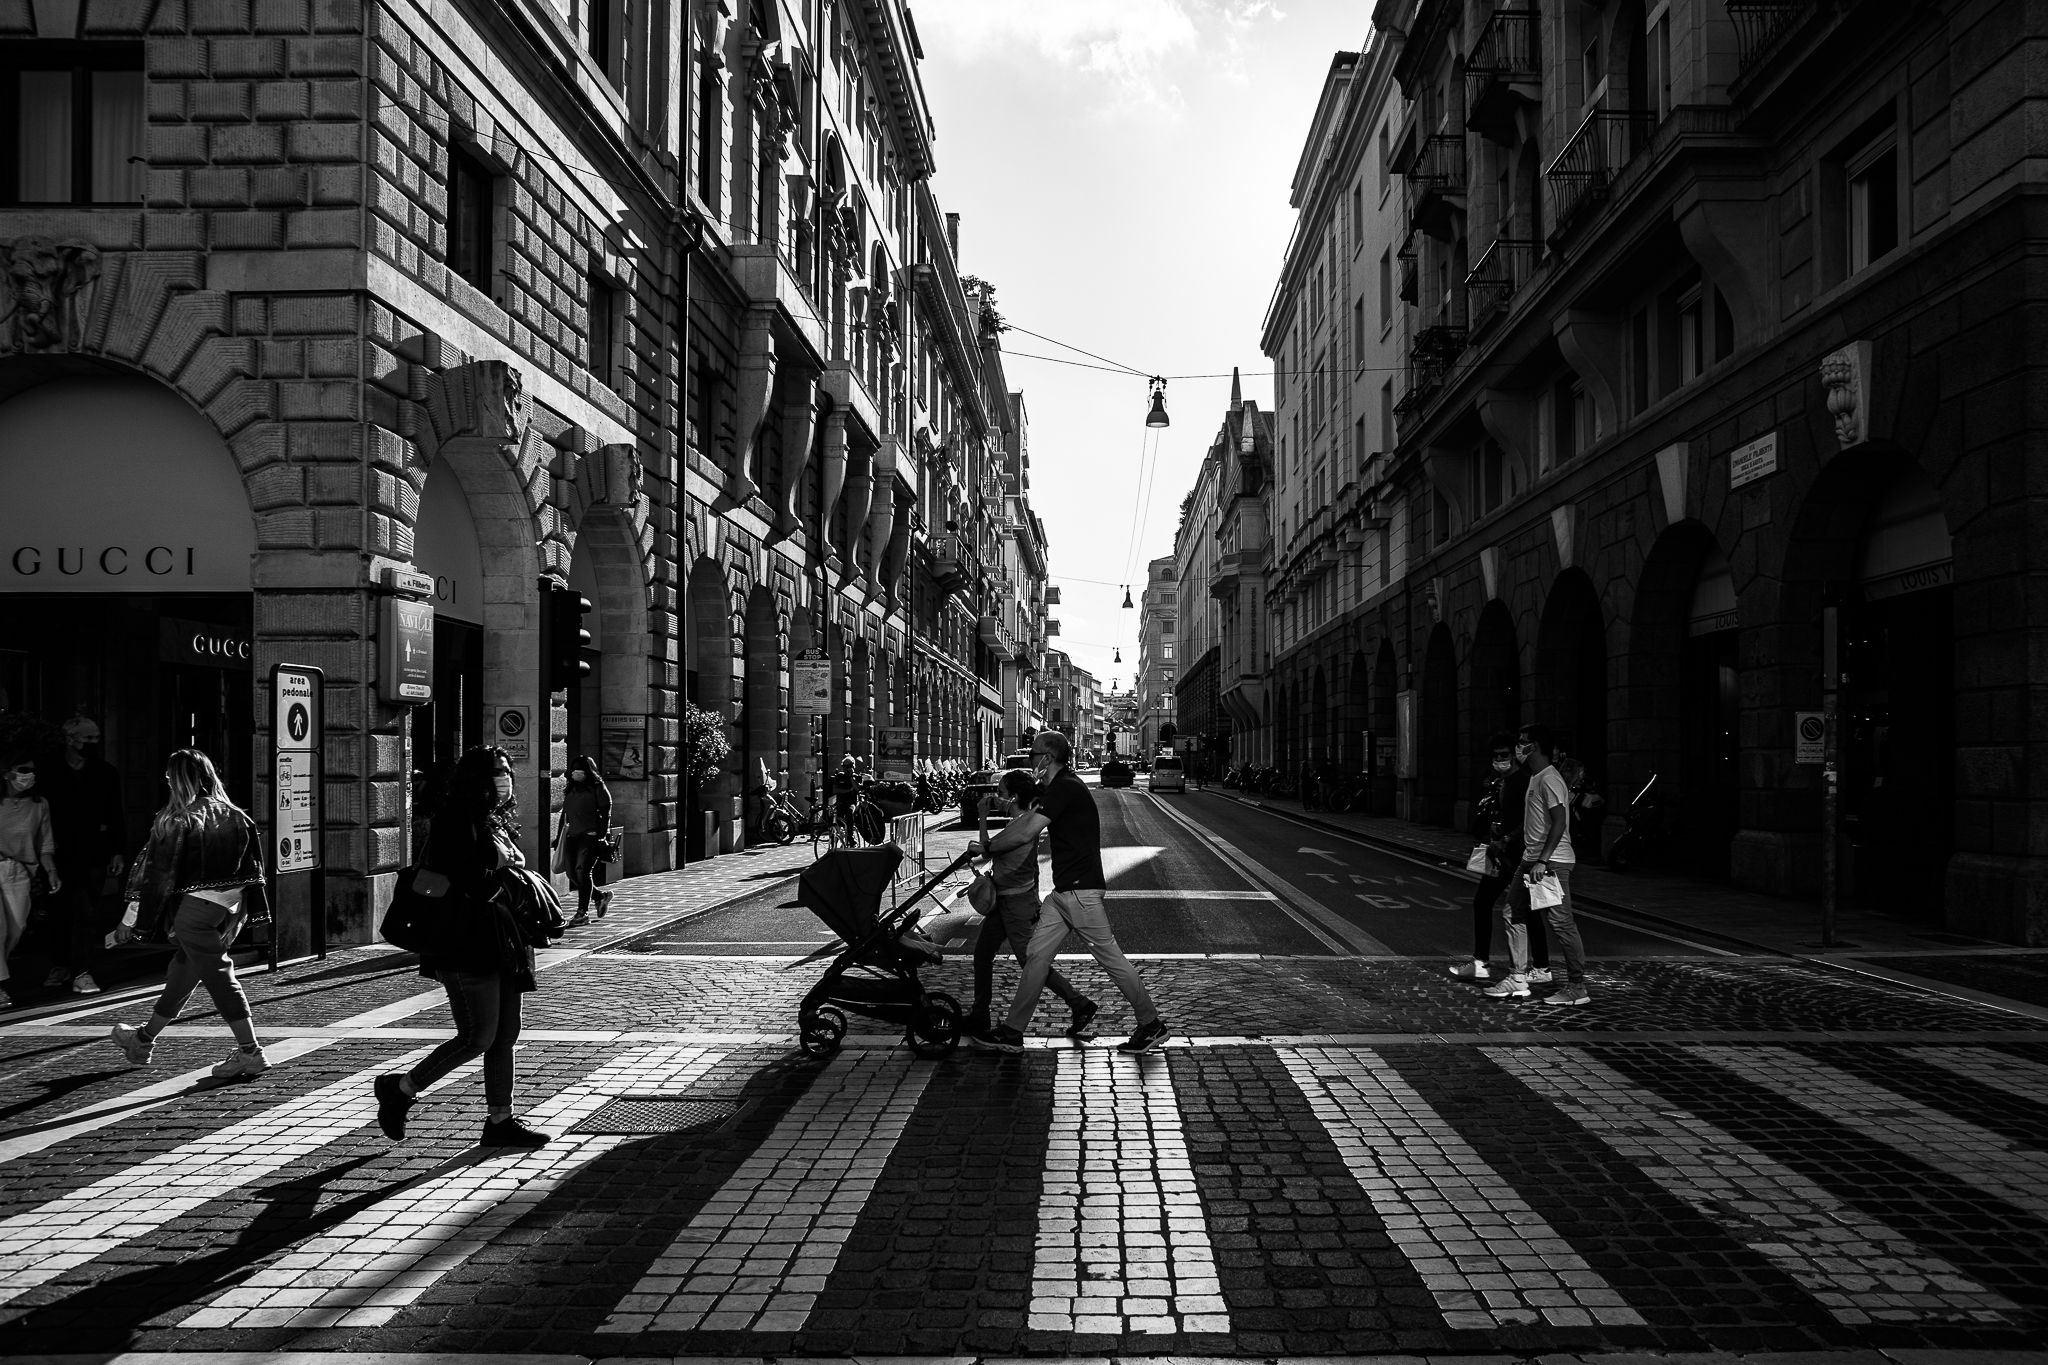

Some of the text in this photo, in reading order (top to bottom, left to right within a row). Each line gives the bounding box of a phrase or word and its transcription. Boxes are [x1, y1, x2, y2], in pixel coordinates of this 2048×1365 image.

[12, 546, 195, 575] GUCCI
[1898, 563, 1951, 590] LOUIS V
[399, 609, 432, 639] NAVIGLI
[1716, 612, 1738, 629] LOUIS
[193, 634, 252, 659] GUCC
[290, 677, 305, 685] area
[282, 687, 313, 698] pedonale
[1305, 873, 1443, 887] TAXI
